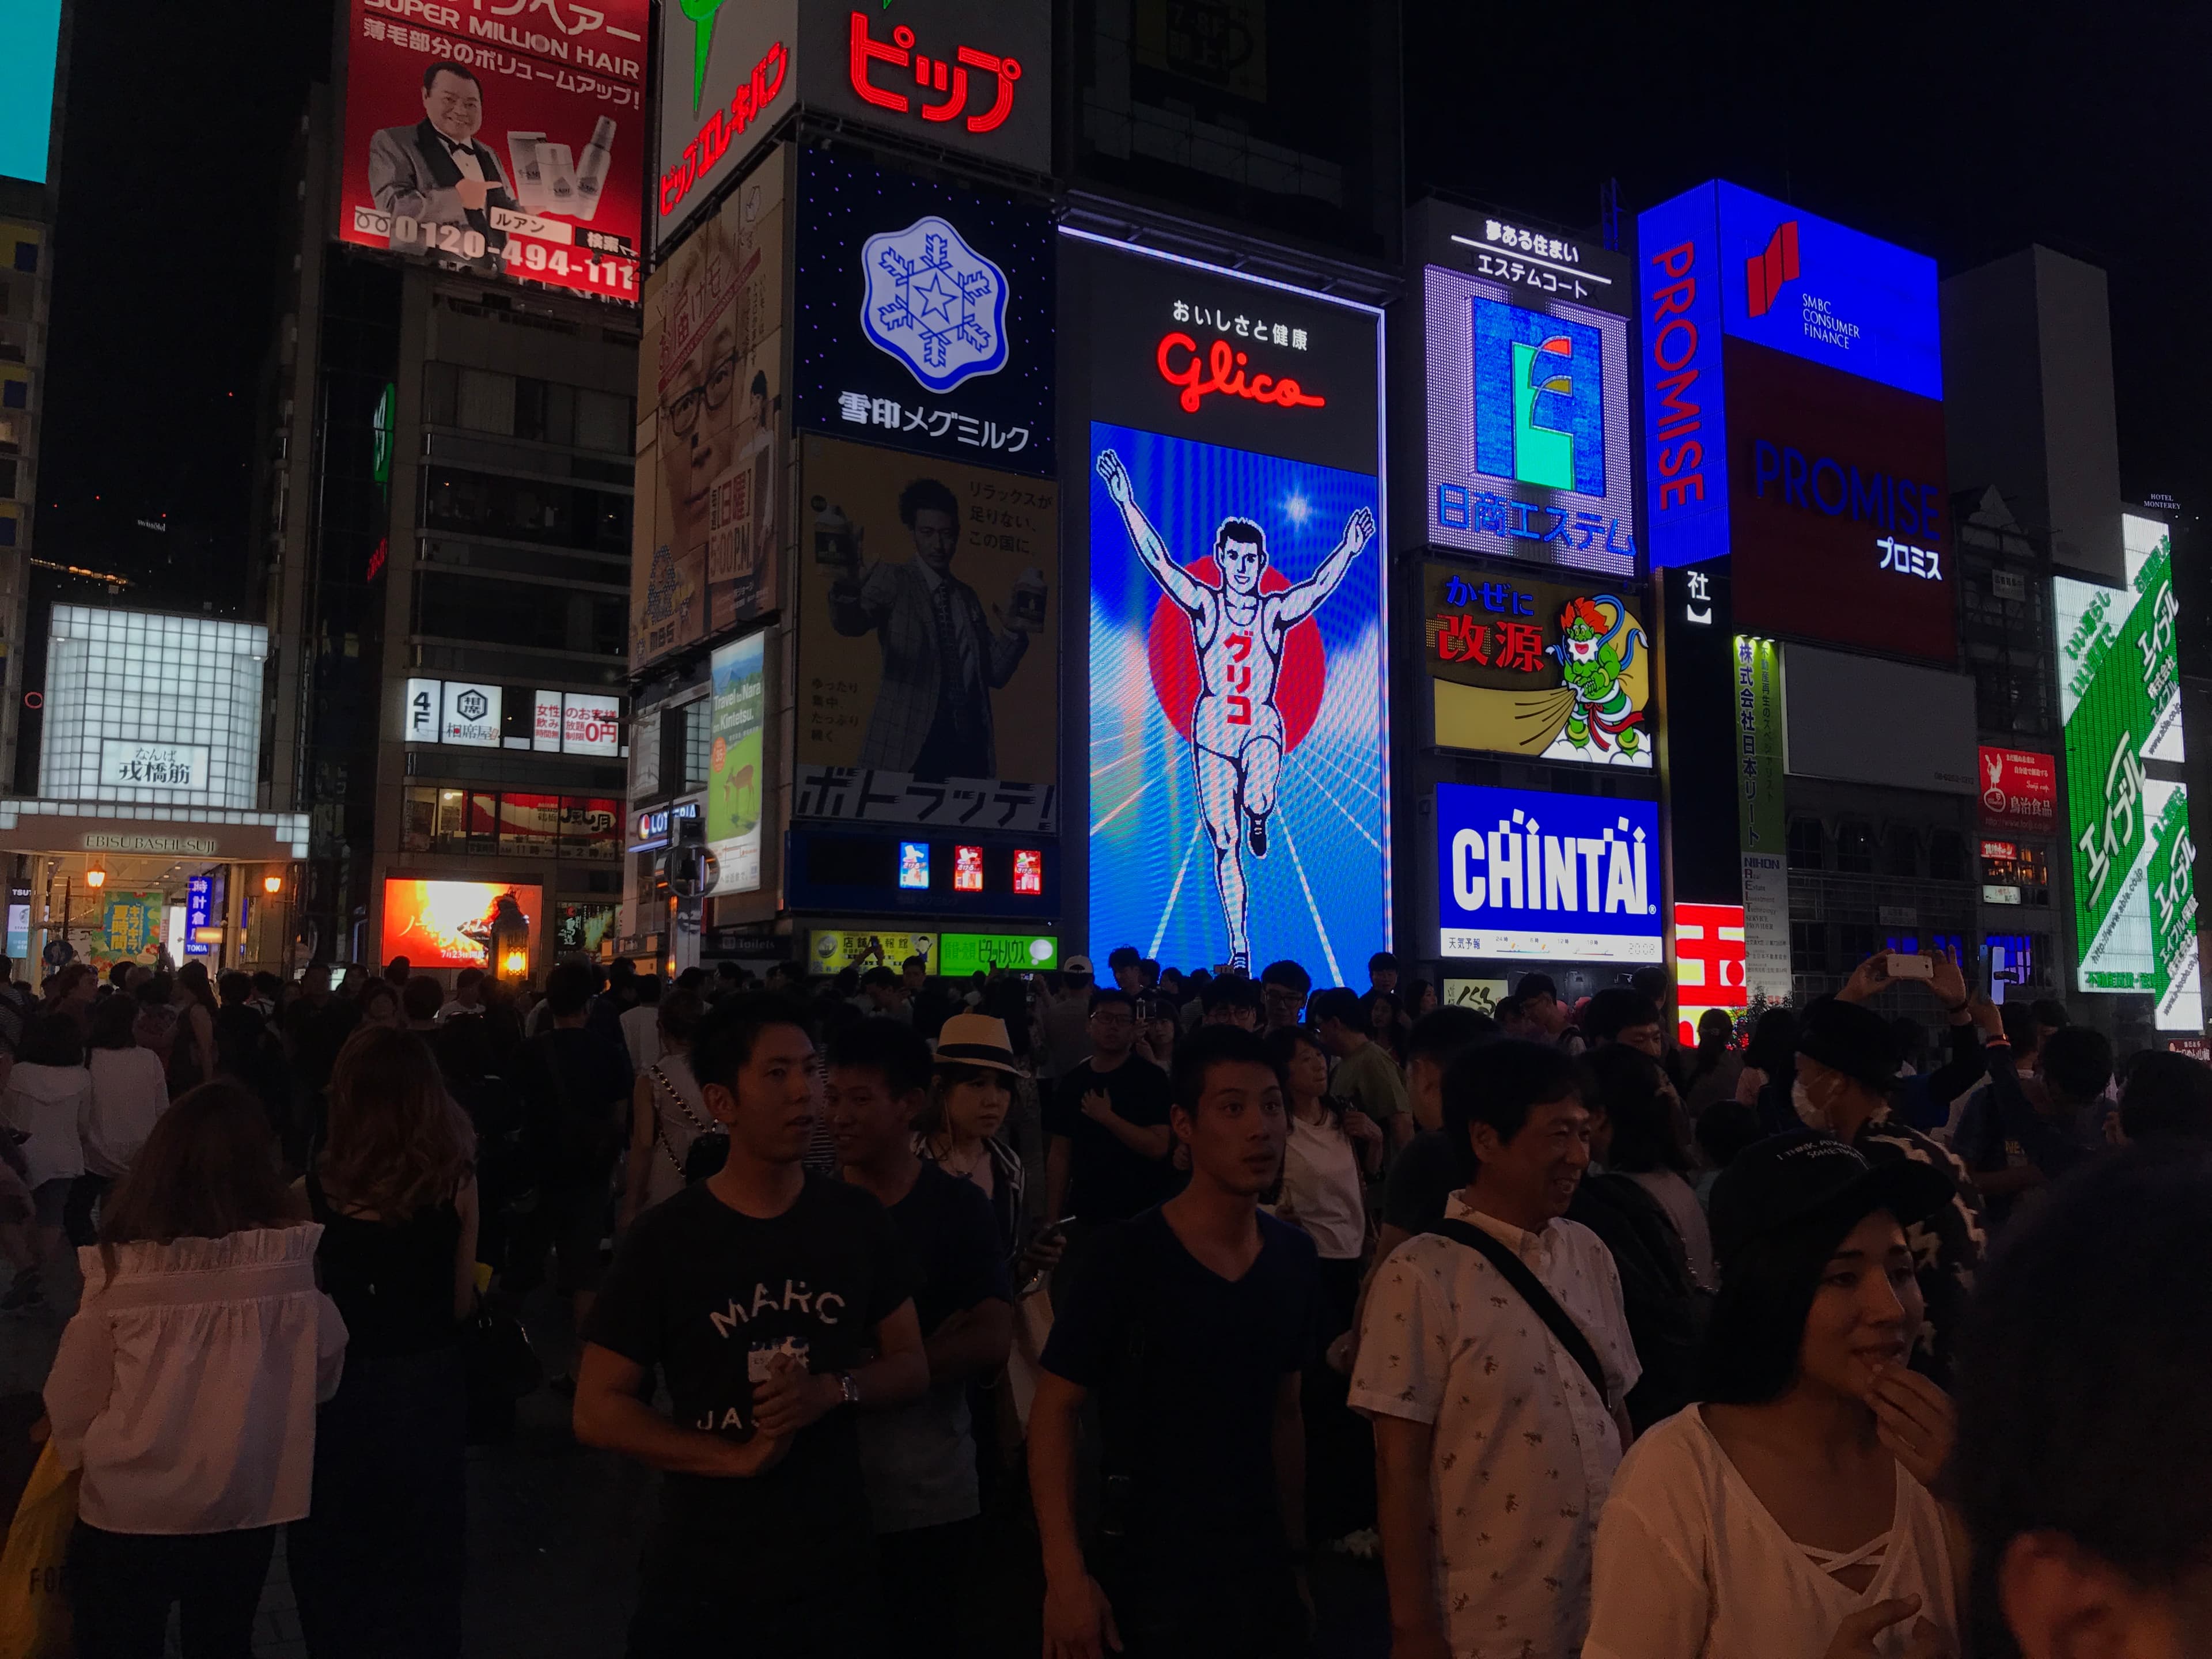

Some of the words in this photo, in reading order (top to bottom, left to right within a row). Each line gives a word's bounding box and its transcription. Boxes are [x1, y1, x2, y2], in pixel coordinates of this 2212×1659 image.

[372, 0, 460, 30] SUPER
[469, 16, 568, 60] MILLION
[577, 45, 640, 79] HAIR
[850, 11, 1022, 134] ピップ
[497, 214, 545, 232] ルアン
[586, 230, 620, 253] 検索
[1486, 220, 1579, 263] 夢ある住まい
[1478, 254, 1588, 300] エステムコート
[1802, 293, 1831, 315] SMBC
[1803, 308, 1861, 339] CONSUMER
[1173, 300, 1308, 351] おいしさと健康
[1804, 322, 1850, 350] FINANCE
[1652, 241, 1705, 510] PROMISE
[838, 390, 1029, 453] 雪印メグミルク
[970, 481, 1054, 509] リラックスが
[1755, 439, 1941, 540] PROMISE
[2143, 500, 2181, 510] MONTEREY
[2150, 493, 2173, 502] HOTEL
[1440, 483, 1637, 557] 日商エステム
[1876, 536, 1944, 581] プロミス
[1446, 575, 1535, 616] かぜに
[1436, 613, 1545, 673] 改源
[2137, 589, 2180, 669] エイブル
[714, 688, 737, 711] Travel
[742, 682, 761, 698] Nara
[1223, 630, 1254, 726] グリコ
[413, 692, 431, 729] 4F
[135, 747, 176, 762] なんば
[1738, 642, 1760, 847] 株式会社日本リート
[119, 760, 191, 784] 戎橋筋
[2079, 749, 2146, 882] エイブル
[87, 835, 131, 849] EBISU
[1452, 808, 1648, 915] CHINTAI
[1744, 857, 1780, 869] NIHON
[189, 880, 207, 941] 時計倉
[187, 944, 207, 952] TOKIA
[843, 937, 908, 949] 店舗報館
[1449, 937, 1480, 950] 天気予報
[710, 1279, 846, 1339] MARC
